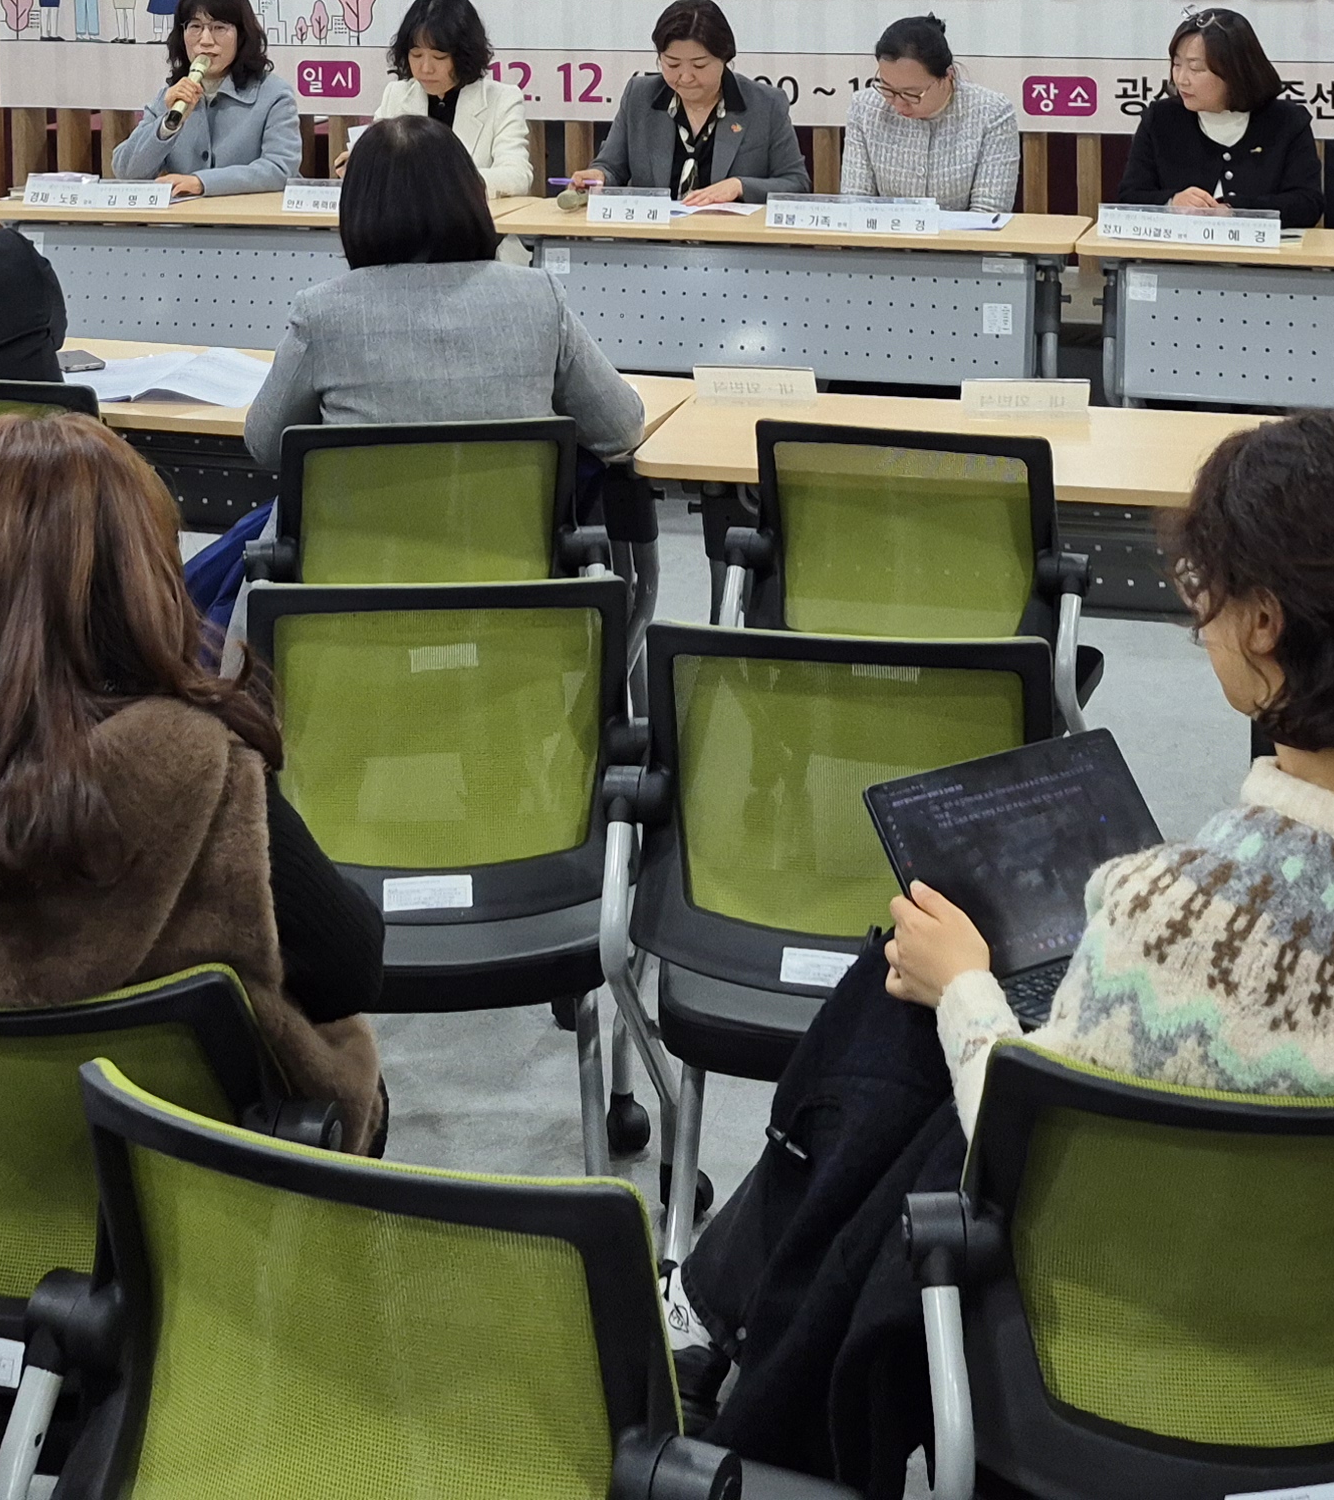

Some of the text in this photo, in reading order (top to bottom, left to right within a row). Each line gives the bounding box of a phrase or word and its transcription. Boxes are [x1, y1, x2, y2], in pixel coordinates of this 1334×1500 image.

[302, 68, 355, 90] 일시
[557, 62, 612, 103] 12.
[1030, 82, 1092, 109] 장소
[30, 192, 49, 203] 경제
[59, 194, 78, 205] 노동
[809, 215, 830, 227] 가족
[1132, 226, 1172, 238] 의사결정
